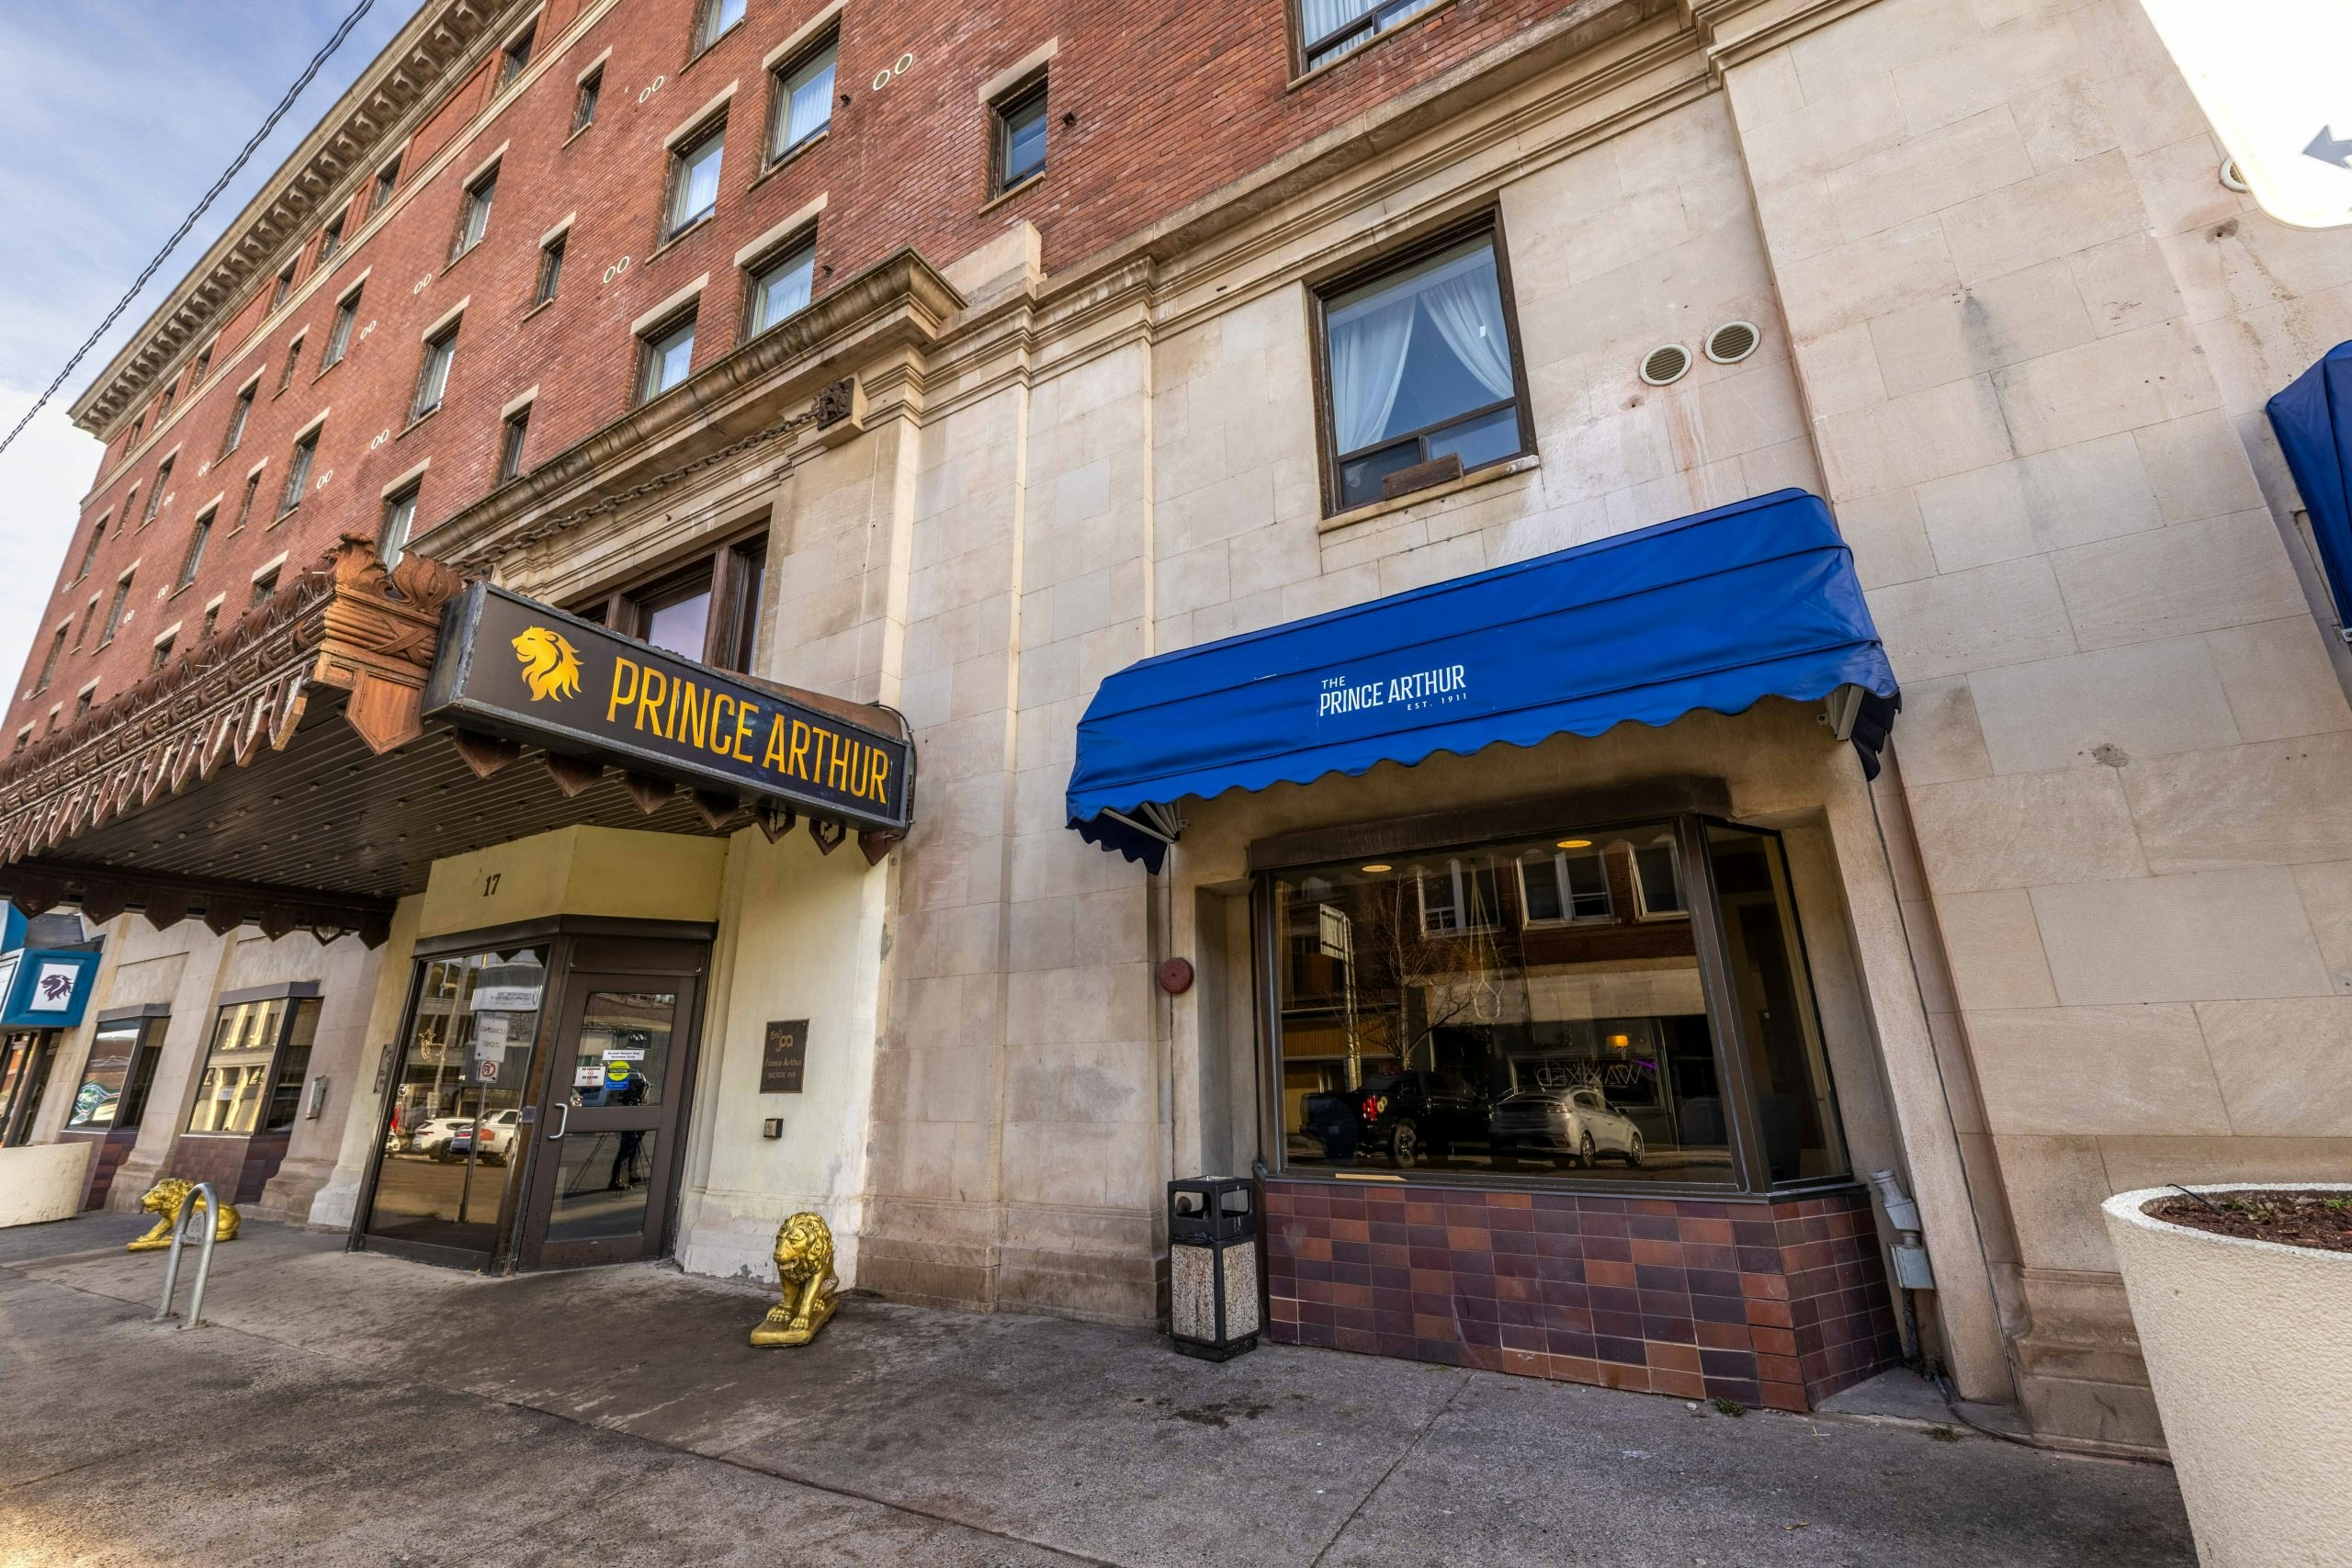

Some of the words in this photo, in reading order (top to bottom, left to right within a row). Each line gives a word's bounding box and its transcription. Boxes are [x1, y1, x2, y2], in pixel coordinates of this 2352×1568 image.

[1319, 682, 1384, 716] PRINCE
[1387, 664, 1466, 704] ARTHUR
[1321, 675, 1346, 689] THE
[1407, 701, 1433, 711] EST.
[1441, 693, 1467, 705] 1911
[606, 656, 760, 763] PRINCE
[762, 713, 889, 805] ARTHUR
[482, 873, 502, 897] 17
[764, 1057, 782, 1067] Prince
[783, 1057, 802, 1067] Arthur
